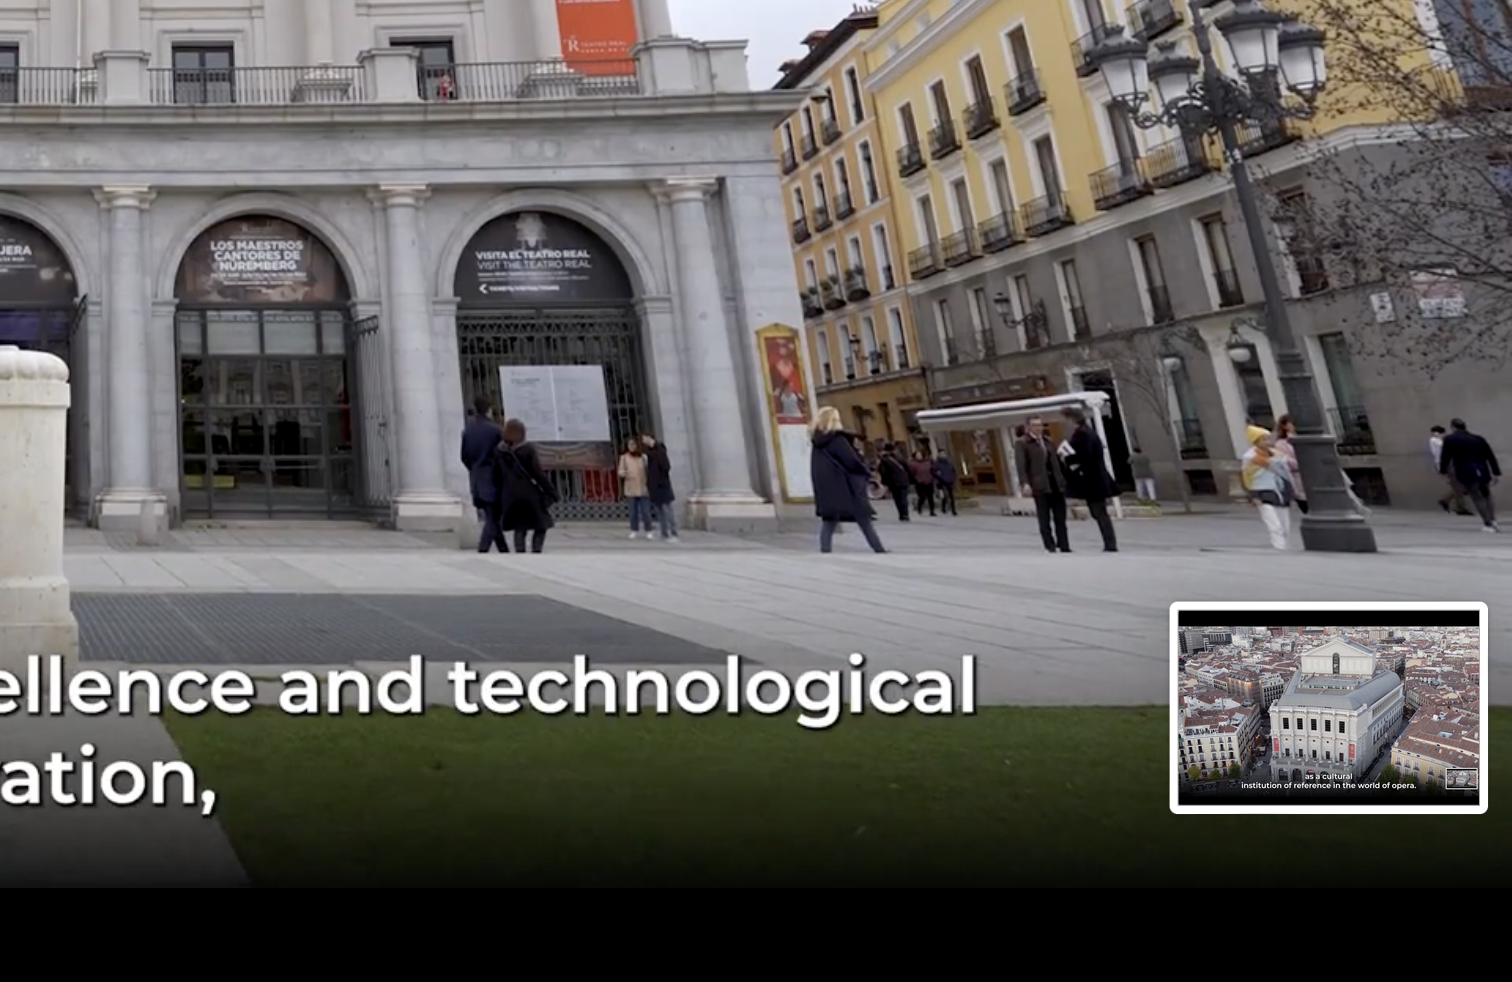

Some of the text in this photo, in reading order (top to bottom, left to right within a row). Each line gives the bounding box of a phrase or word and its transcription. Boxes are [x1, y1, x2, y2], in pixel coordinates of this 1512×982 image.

[210, 240, 303, 251] LOS MAESTROS
[214, 250, 301, 261] CANTORES DE
[475, 250, 590, 260] VISITA EL TEATRO REAL
[478, 259, 592, 270] VISIT THE TEATRO REAL
